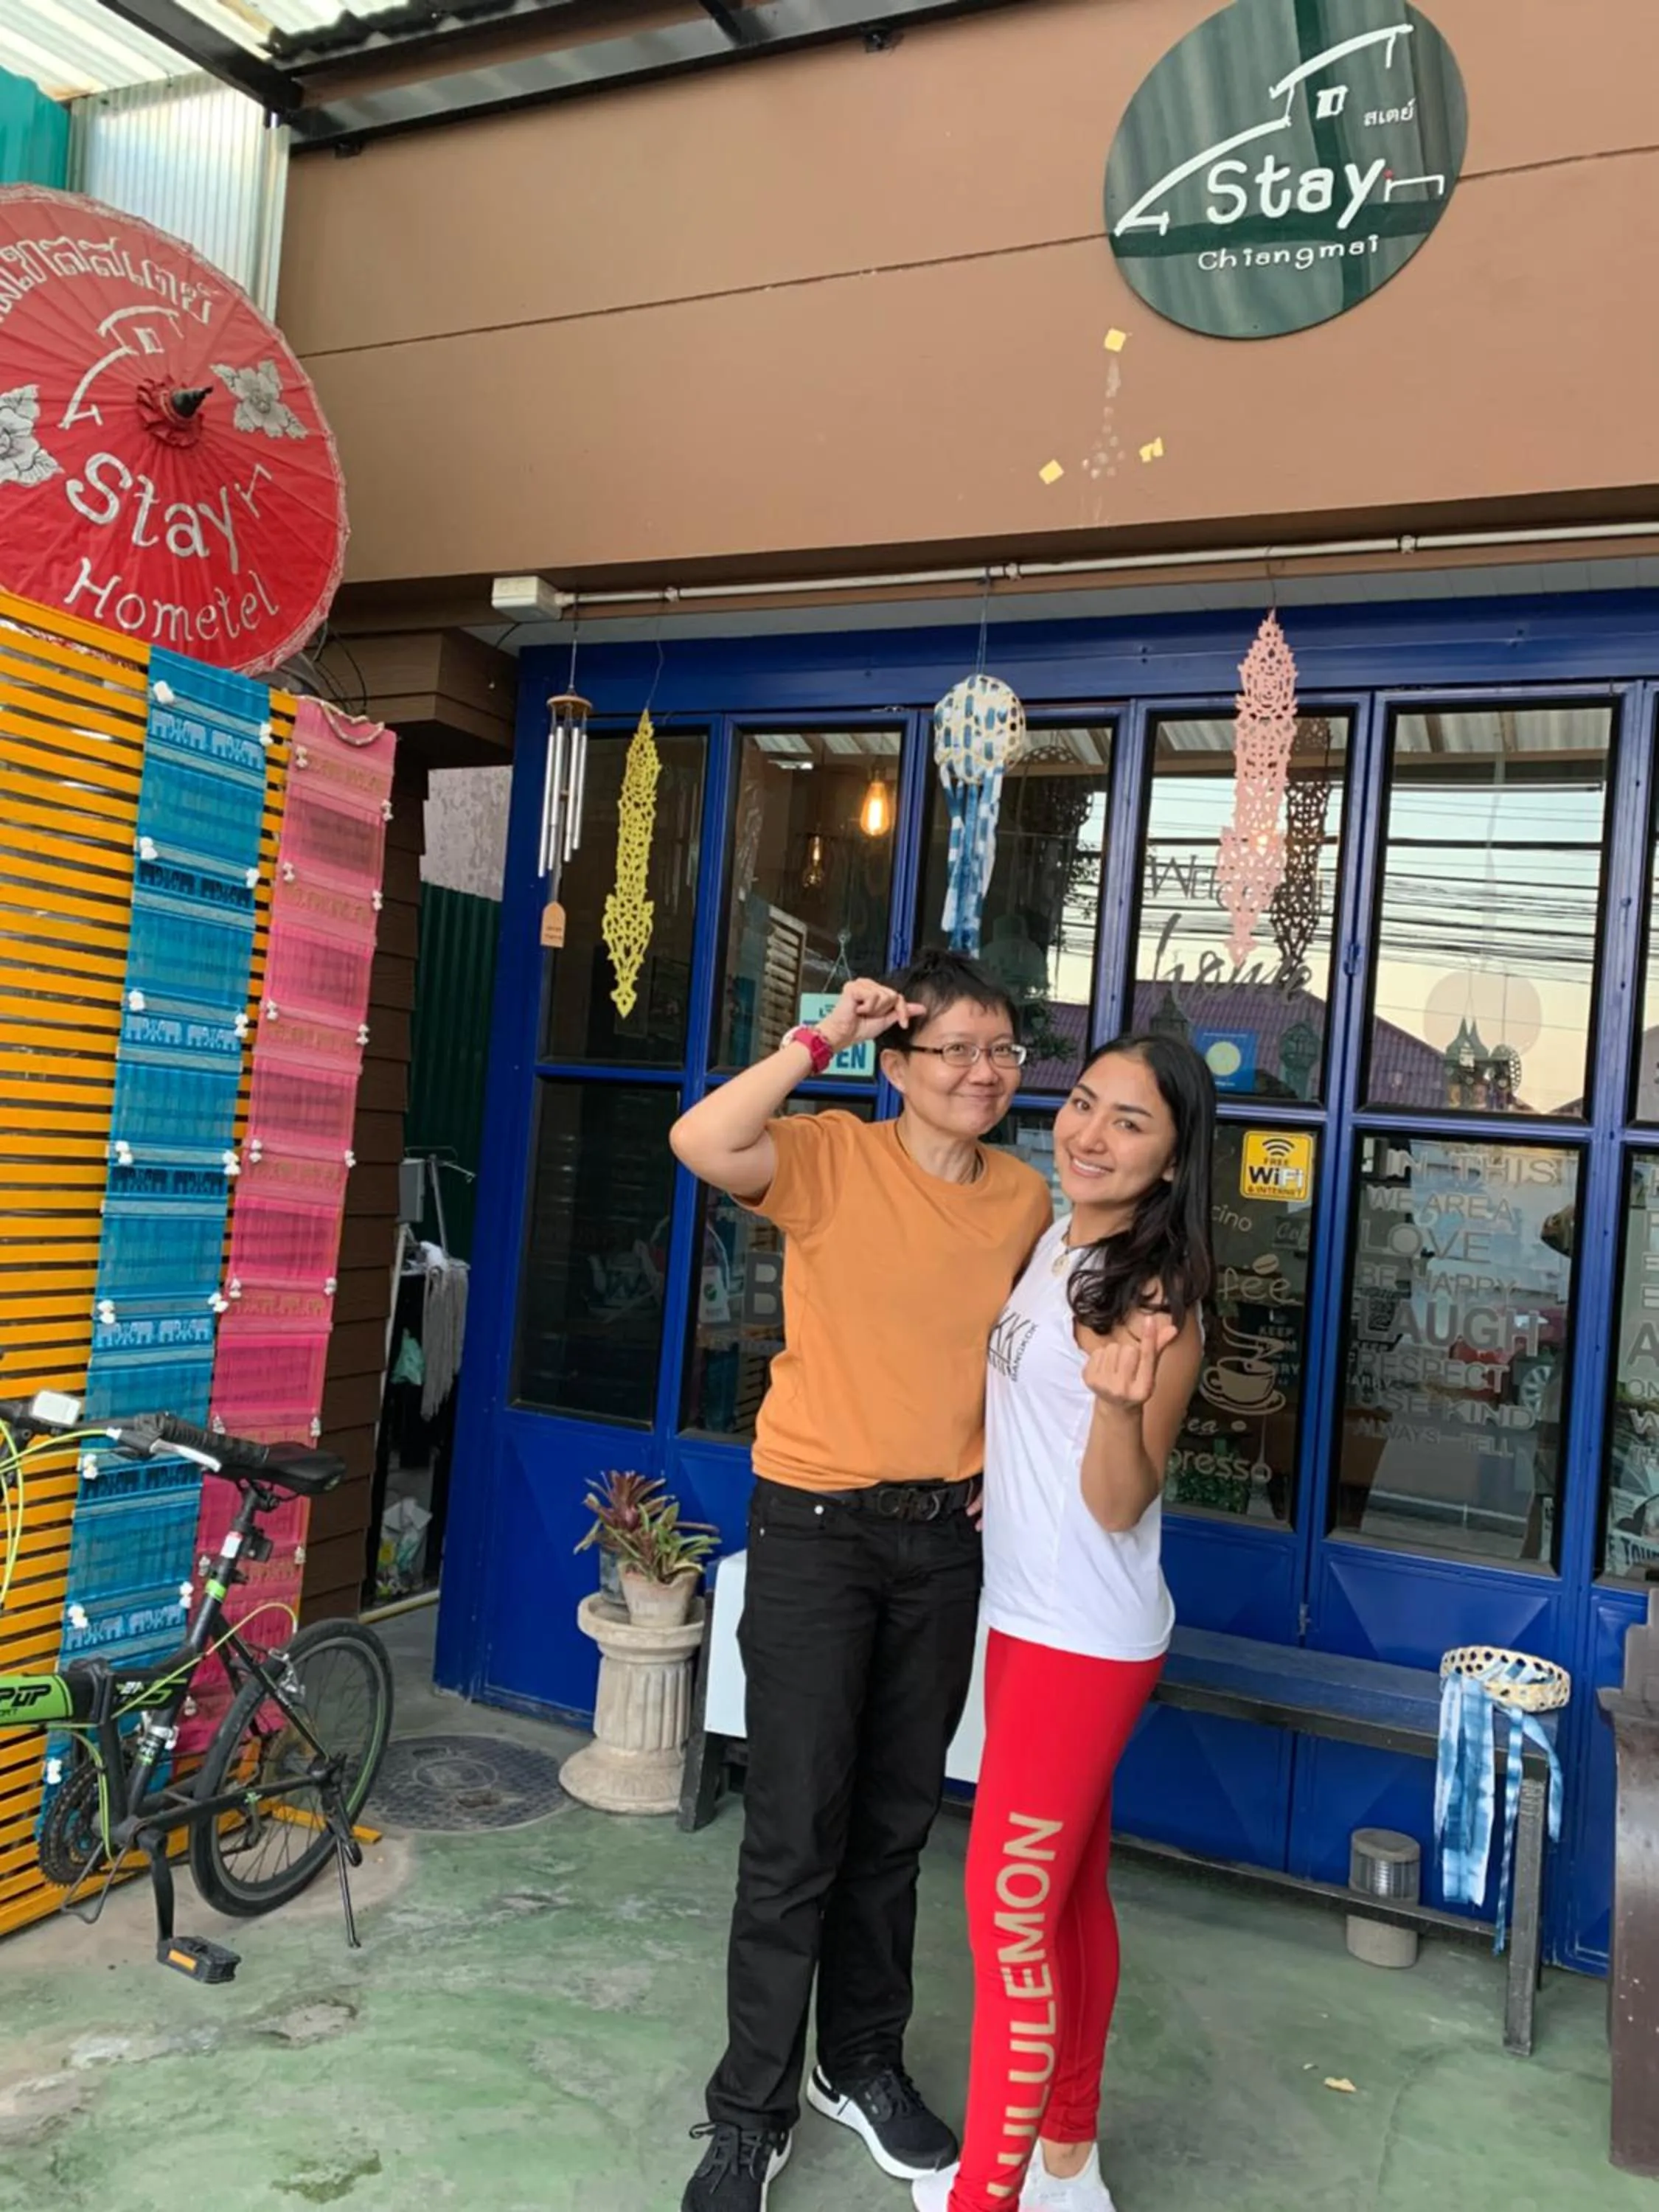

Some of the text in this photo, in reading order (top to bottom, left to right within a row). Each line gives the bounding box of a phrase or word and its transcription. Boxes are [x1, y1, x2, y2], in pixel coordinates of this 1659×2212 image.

[1197, 235, 1379, 271] Chiangmai
[63, 557, 280, 642] Hometel
[835, 1042, 867, 1070] EN
[1450, 1151, 1562, 1189] THIS
[1422, 1189, 1489, 1221] ARE
[1361, 1218, 1492, 1265] LOVE
[1411, 1265, 1517, 1301] HAPPY
[1358, 1295, 1540, 1357] LAUGH
[1358, 1351, 1511, 1394] RESPECT
[1441, 1398, 1537, 1431] KIND
